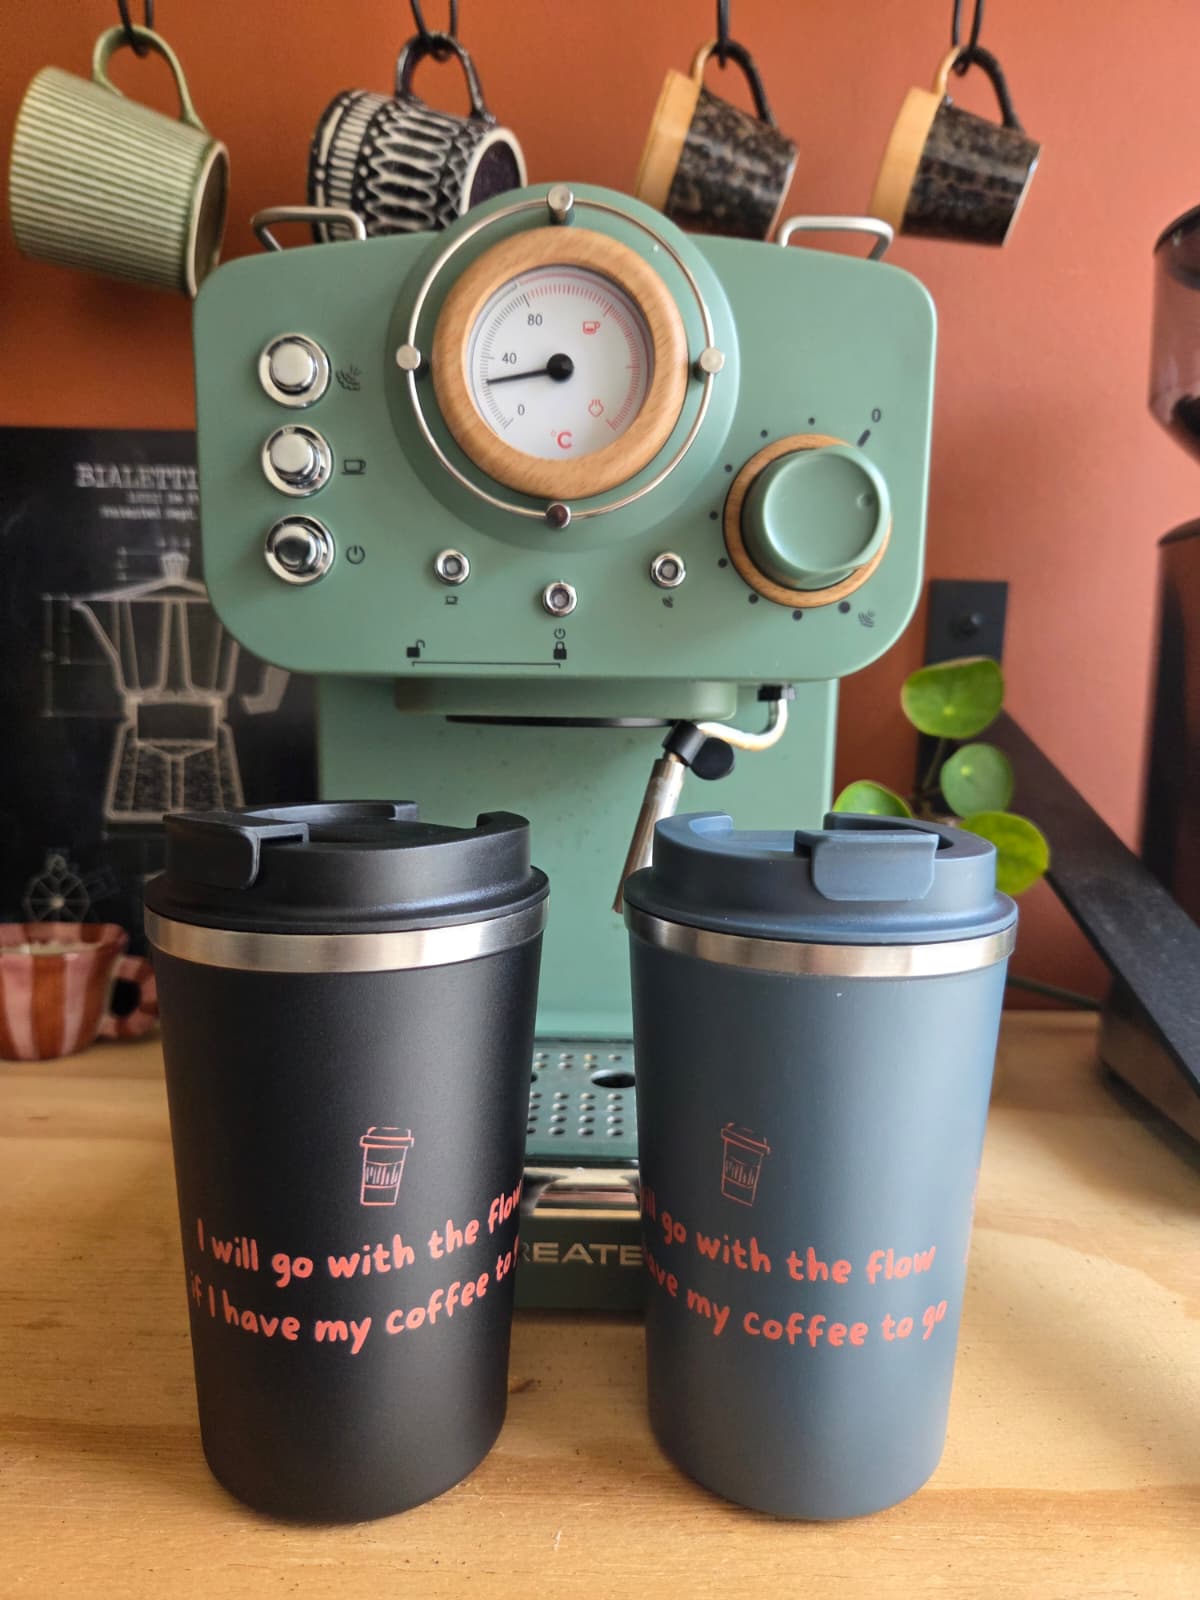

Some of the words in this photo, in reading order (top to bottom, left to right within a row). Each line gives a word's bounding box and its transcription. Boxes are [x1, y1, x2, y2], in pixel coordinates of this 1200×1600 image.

[527, 313, 543, 327] 80
[502, 352, 517, 365] 40
[517, 404, 526, 417] 0
[75, 462, 198, 489] BIALETTI
[212, 1236, 260, 1273] will
[272, 1252, 314, 1289] go
[328, 1234, 415, 1280] with
[429, 1218, 480, 1260] the
[661, 1211, 687, 1246] go
[696, 1232, 772, 1274] with
[786, 1246, 852, 1285] the
[866, 1245, 937, 1285] flow
[222, 1288, 301, 1342] have
[314, 1316, 373, 1356] my
[386, 1271, 490, 1335] coffee
[496, 1253, 513, 1282] to
[686, 1289, 731, 1337] my
[743, 1311, 869, 1348] coffee
[881, 1313, 914, 1342] to
[923, 1300, 949, 1340] go
